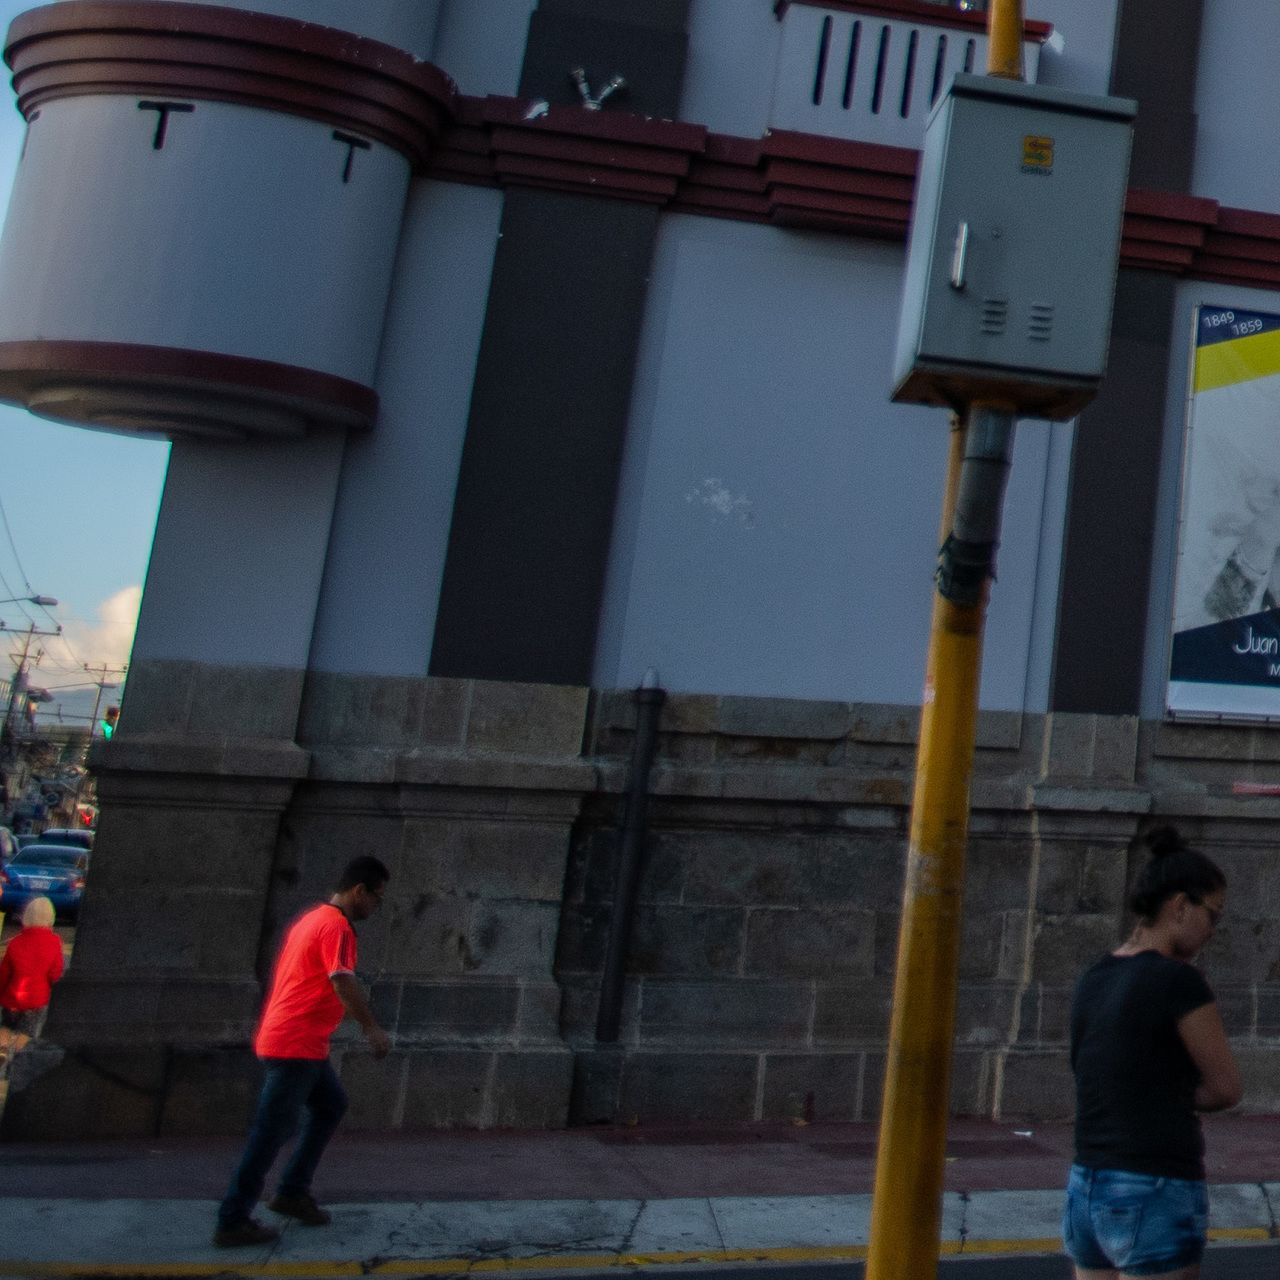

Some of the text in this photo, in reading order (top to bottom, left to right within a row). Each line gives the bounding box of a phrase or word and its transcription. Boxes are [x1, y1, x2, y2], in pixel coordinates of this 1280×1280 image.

[1204, 311, 1235, 328] 1849
[1231, 318, 1263, 336] 1859
[1233, 626, 1278, 654] Juan
